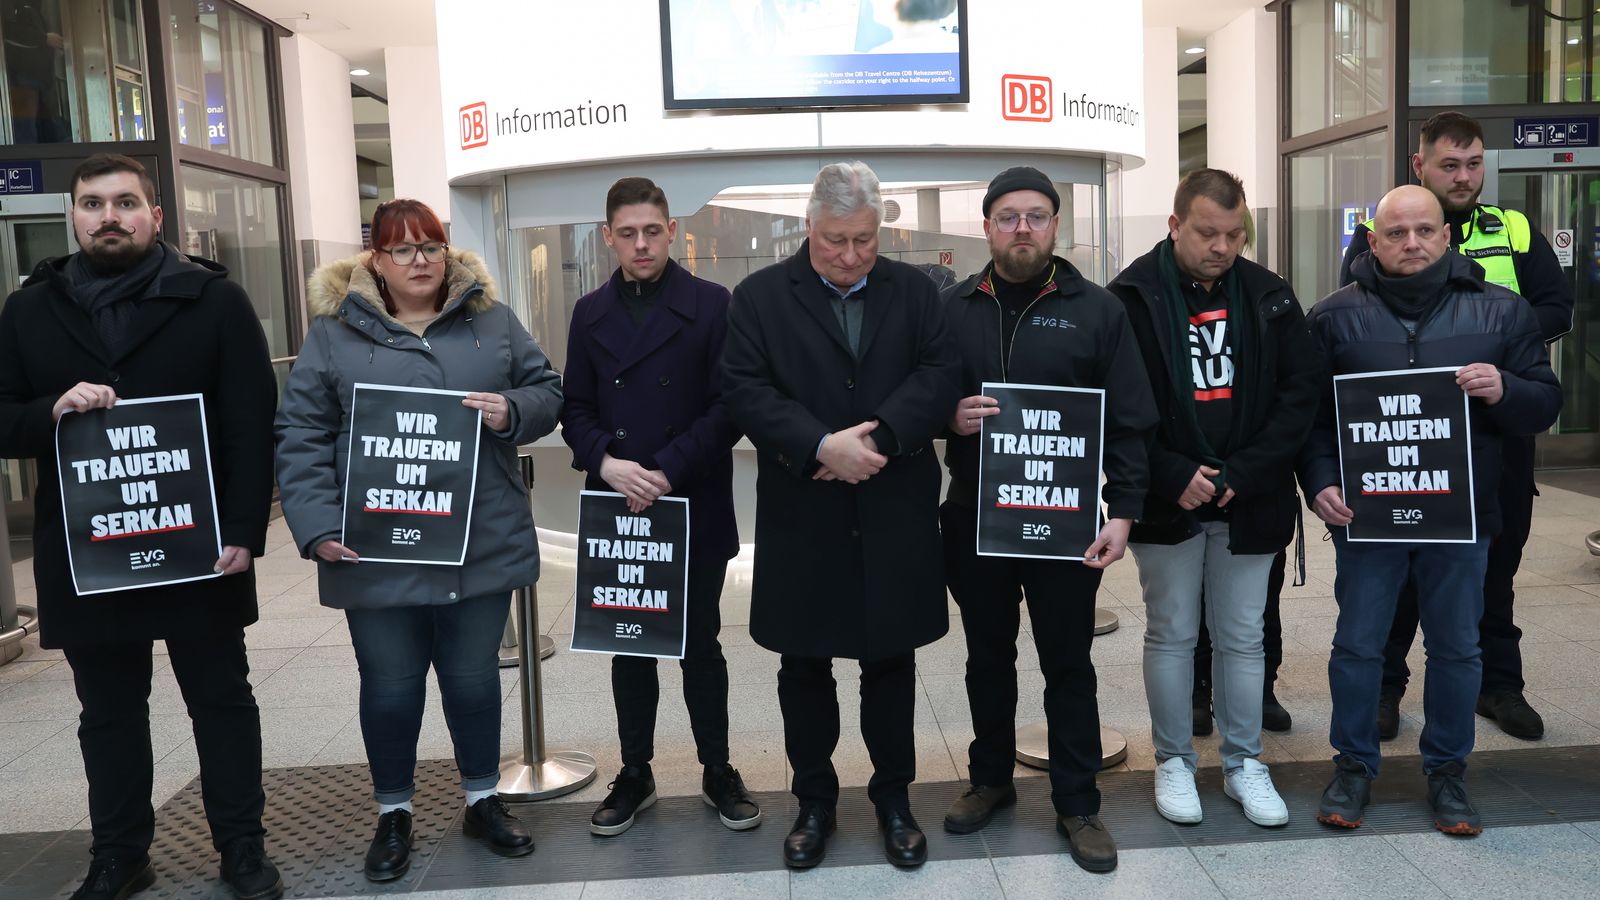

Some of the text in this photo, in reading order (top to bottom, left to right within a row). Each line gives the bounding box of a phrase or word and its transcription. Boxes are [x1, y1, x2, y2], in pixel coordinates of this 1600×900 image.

[1008, 82, 1140, 128] DB Information
[462, 99, 627, 144] DB Information
[1031, 316, 1057, 327] EVG
[1379, 395, 1421, 416] WIR
[396, 412, 437, 434] WIR
[1022, 409, 1061, 430] WIR
[1349, 418, 1450, 442] TRAUERN
[106, 425, 157, 450] WIR
[361, 436, 461, 461] TRAUERN
[991, 433, 1085, 457] TRAUERN
[72, 449, 191, 484] TRAUERN
[1388, 446, 1419, 466] UM
[396, 464, 427, 485] UM
[1025, 460, 1053, 481] UM
[1362, 470, 1449, 492] SERKAN
[121, 480, 158, 505] UM
[366, 488, 452, 513] SERKAN
[998, 484, 1079, 508] SERKAN
[91, 503, 193, 537] SERKAN
[1392, 509, 1423, 520] EVG
[392, 528, 422, 541] EVG
[616, 516, 651, 536] WIR
[1022, 523, 1051, 536] EVG
[130, 550, 165, 565] EVG
[587, 538, 673, 562] TRAUERN
[618, 564, 644, 584] UM
[593, 586, 667, 609] SERKAN
[615, 623, 642, 635] EVG
